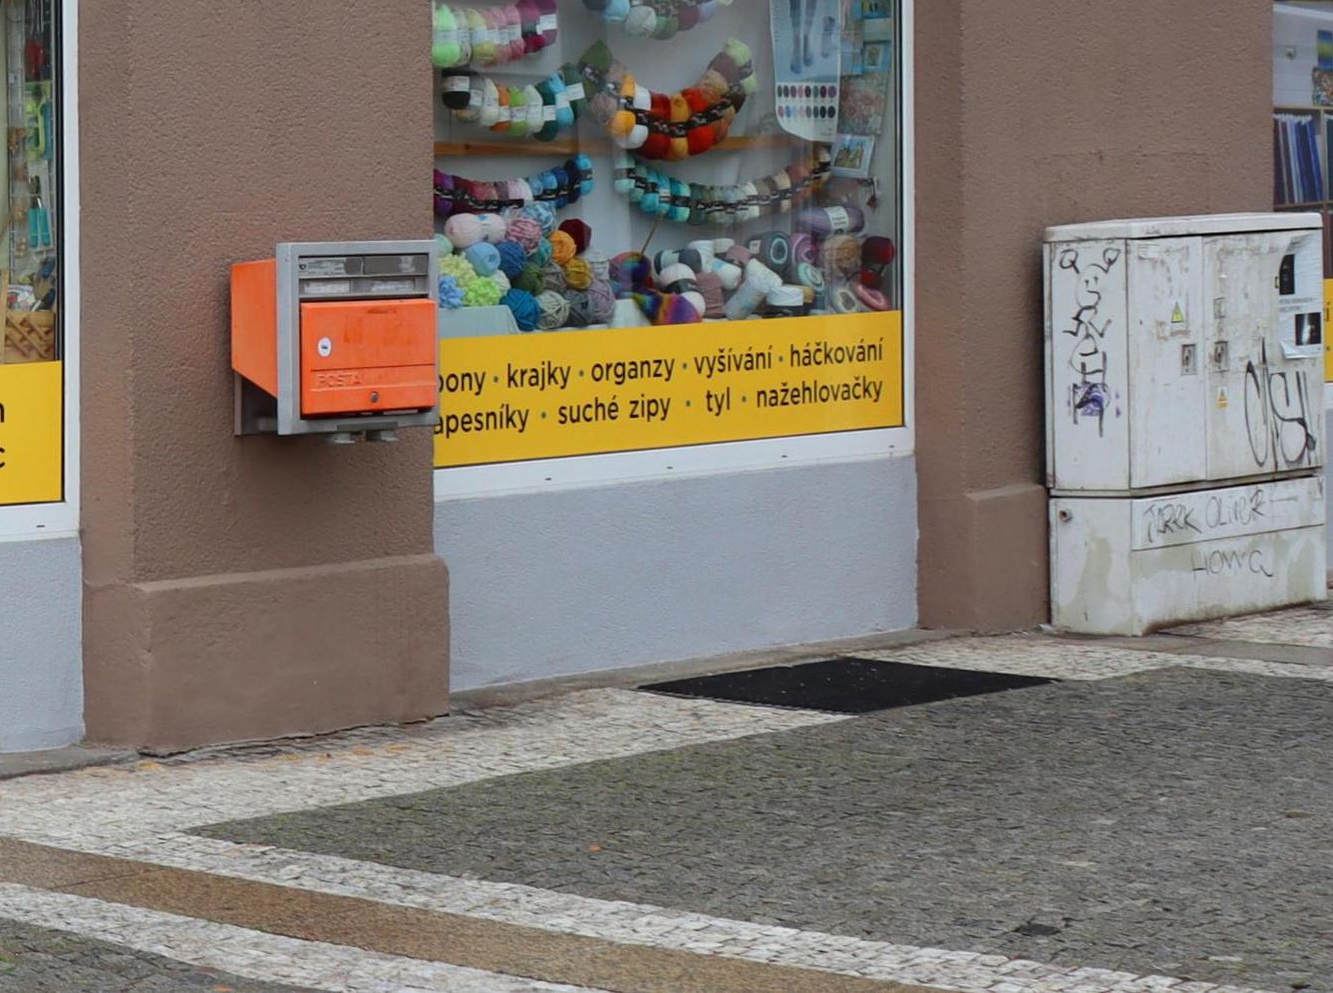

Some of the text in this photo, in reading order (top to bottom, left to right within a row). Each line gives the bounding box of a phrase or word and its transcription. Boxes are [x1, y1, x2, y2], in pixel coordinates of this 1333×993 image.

[507, 360, 571, 390] krajky
[591, 358, 675, 386] organzy
[694, 345, 773, 379] vyšívání
[790, 337, 884, 368] háčkování
[558, 395, 619, 425] suché
[629, 394, 671, 422] zipy
[706, 387, 730, 416] tyl
[757, 375, 883, 408] nažehlovačky
